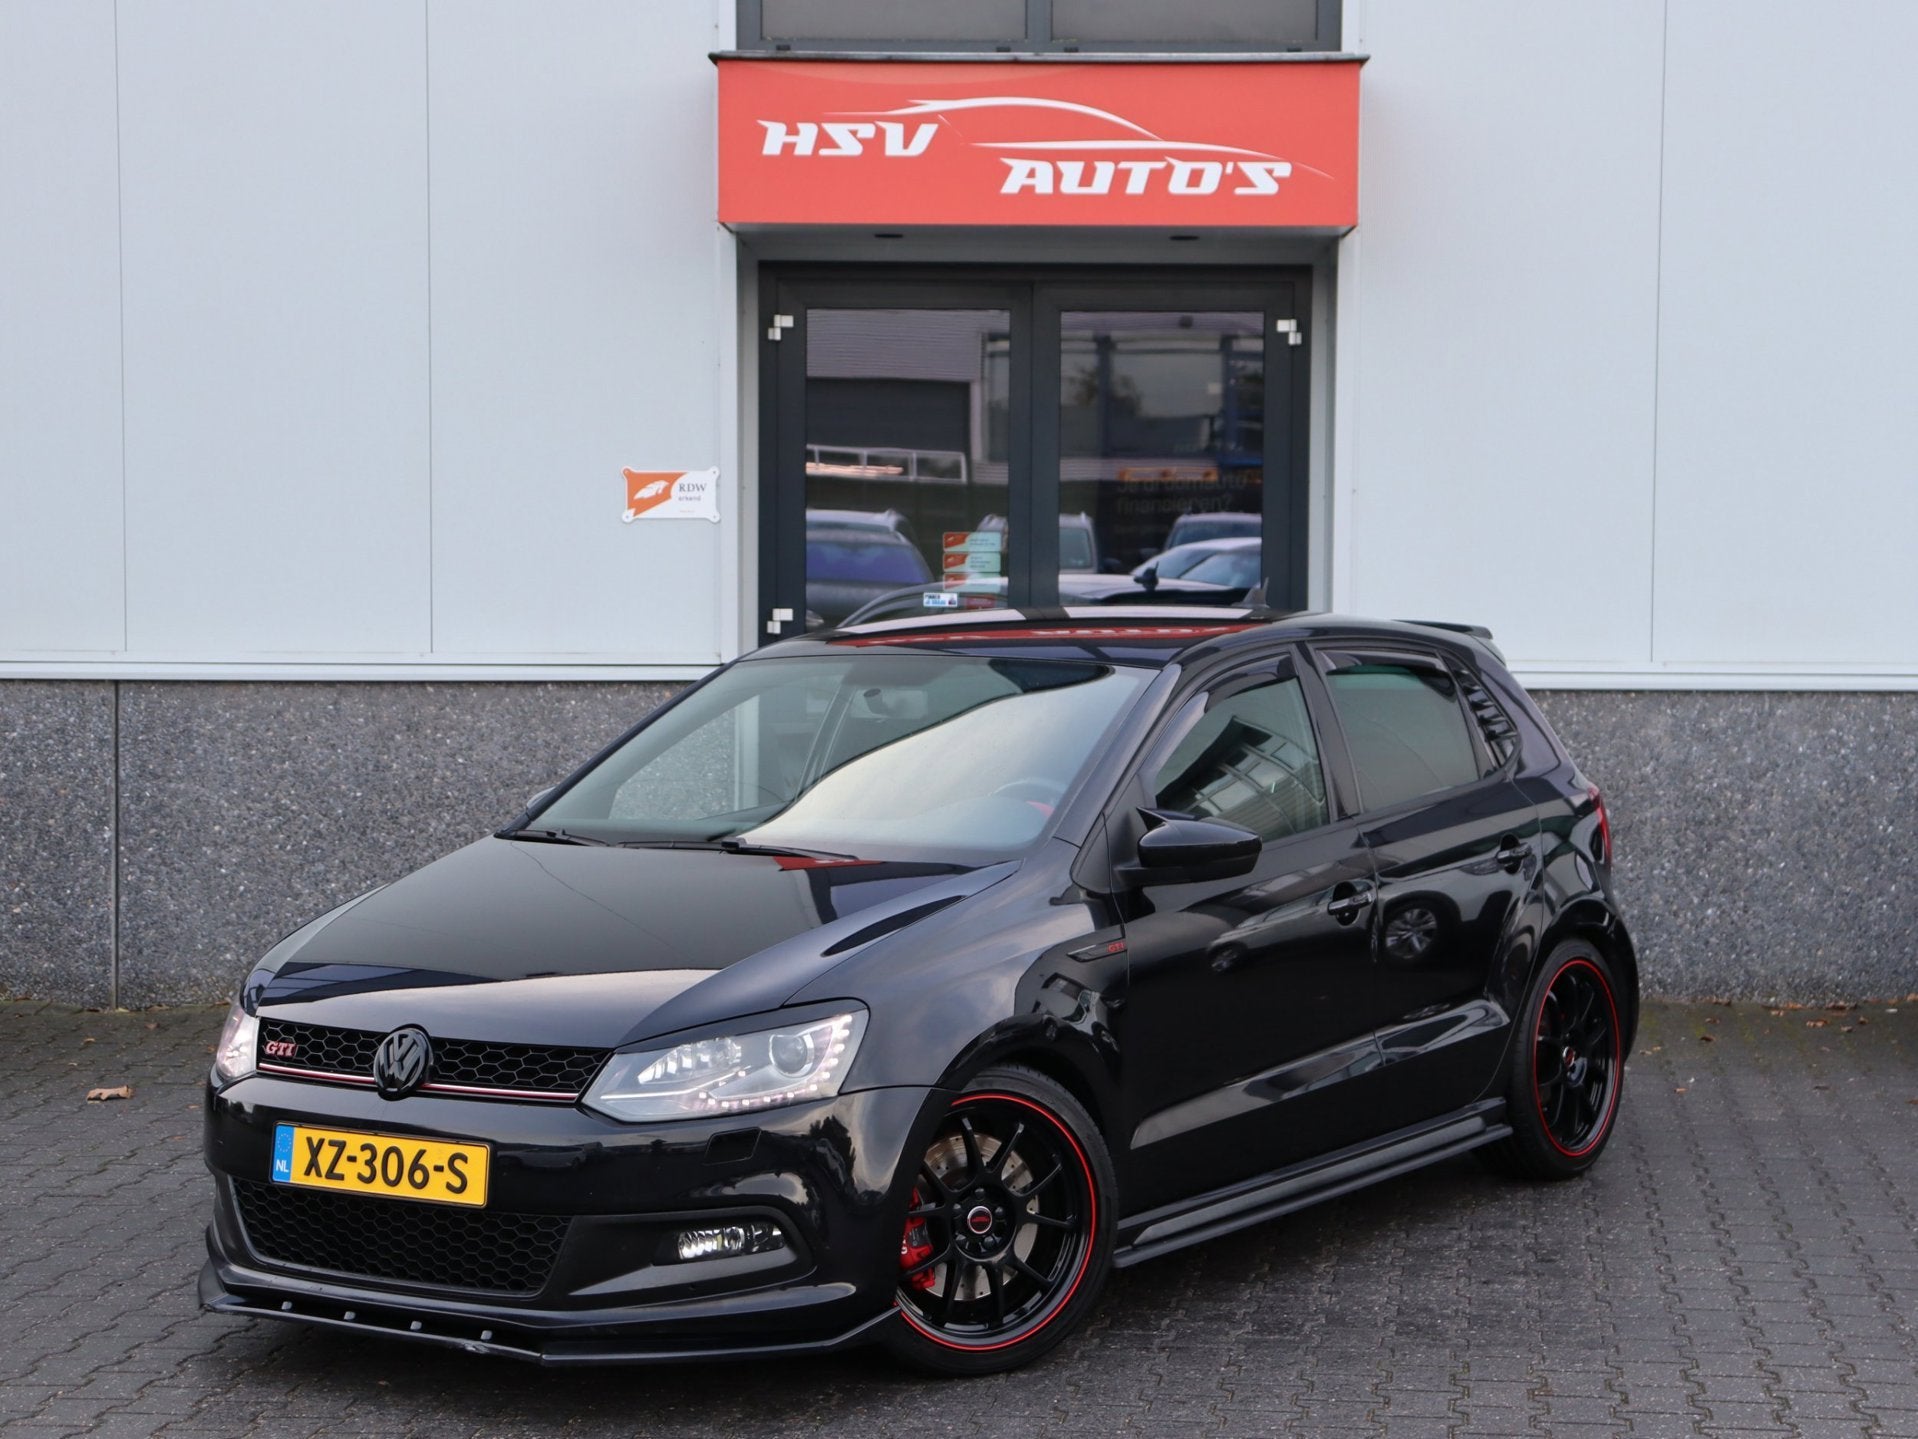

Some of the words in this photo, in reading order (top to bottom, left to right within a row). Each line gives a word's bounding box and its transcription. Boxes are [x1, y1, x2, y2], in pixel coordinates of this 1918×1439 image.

[757, 119, 939, 157] HSV
[1000, 156, 1292, 196] AUTO'S
[679, 483, 706, 492] RDW
[265, 1041, 297, 1057] GTI
[275, 1160, 289, 1173] NL
[304, 1136, 468, 1194] XZ-306-S
